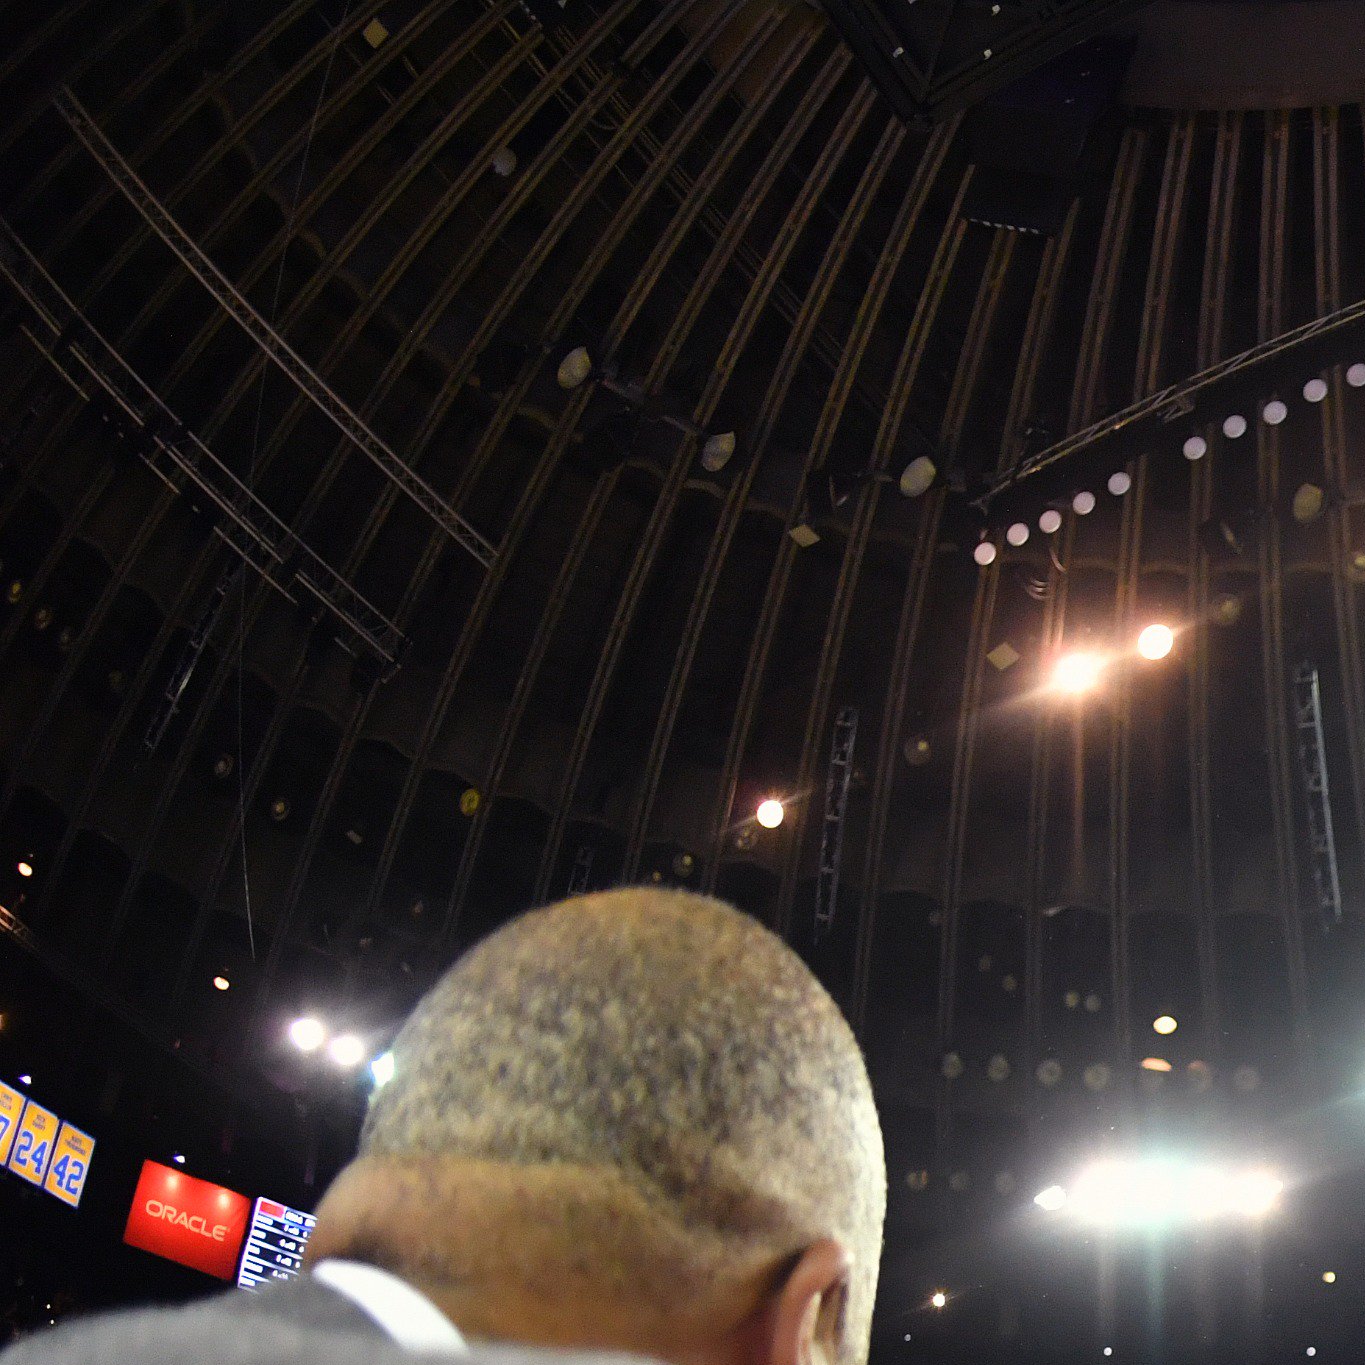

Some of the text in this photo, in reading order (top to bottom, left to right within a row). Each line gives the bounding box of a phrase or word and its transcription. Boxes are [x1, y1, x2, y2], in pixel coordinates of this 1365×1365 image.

[14, 1130, 48, 1174] 24
[53, 1154, 84, 1195] 42
[145, 1199, 228, 1242] ORACLE
